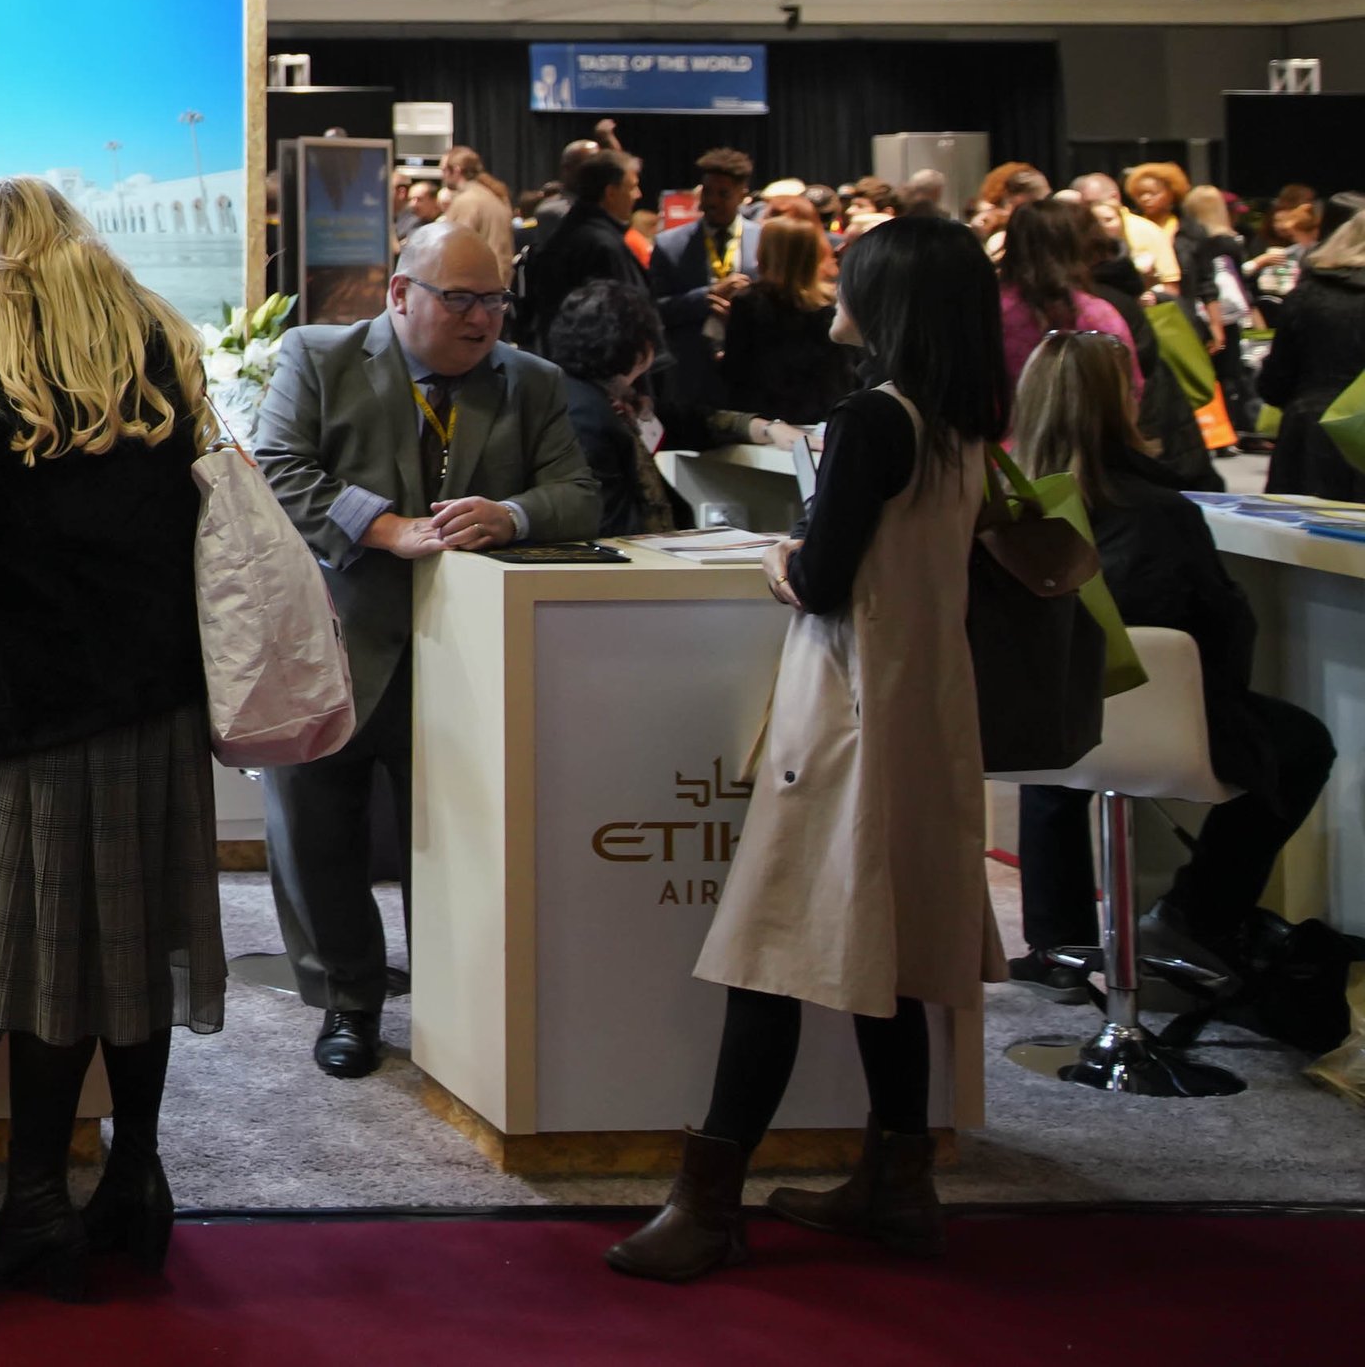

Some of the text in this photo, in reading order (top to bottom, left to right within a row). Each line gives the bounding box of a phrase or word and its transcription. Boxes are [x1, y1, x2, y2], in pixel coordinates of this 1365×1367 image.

[577, 54, 752, 73] TASTE OF THE WORLD
[658, 879, 718, 905] AIR
